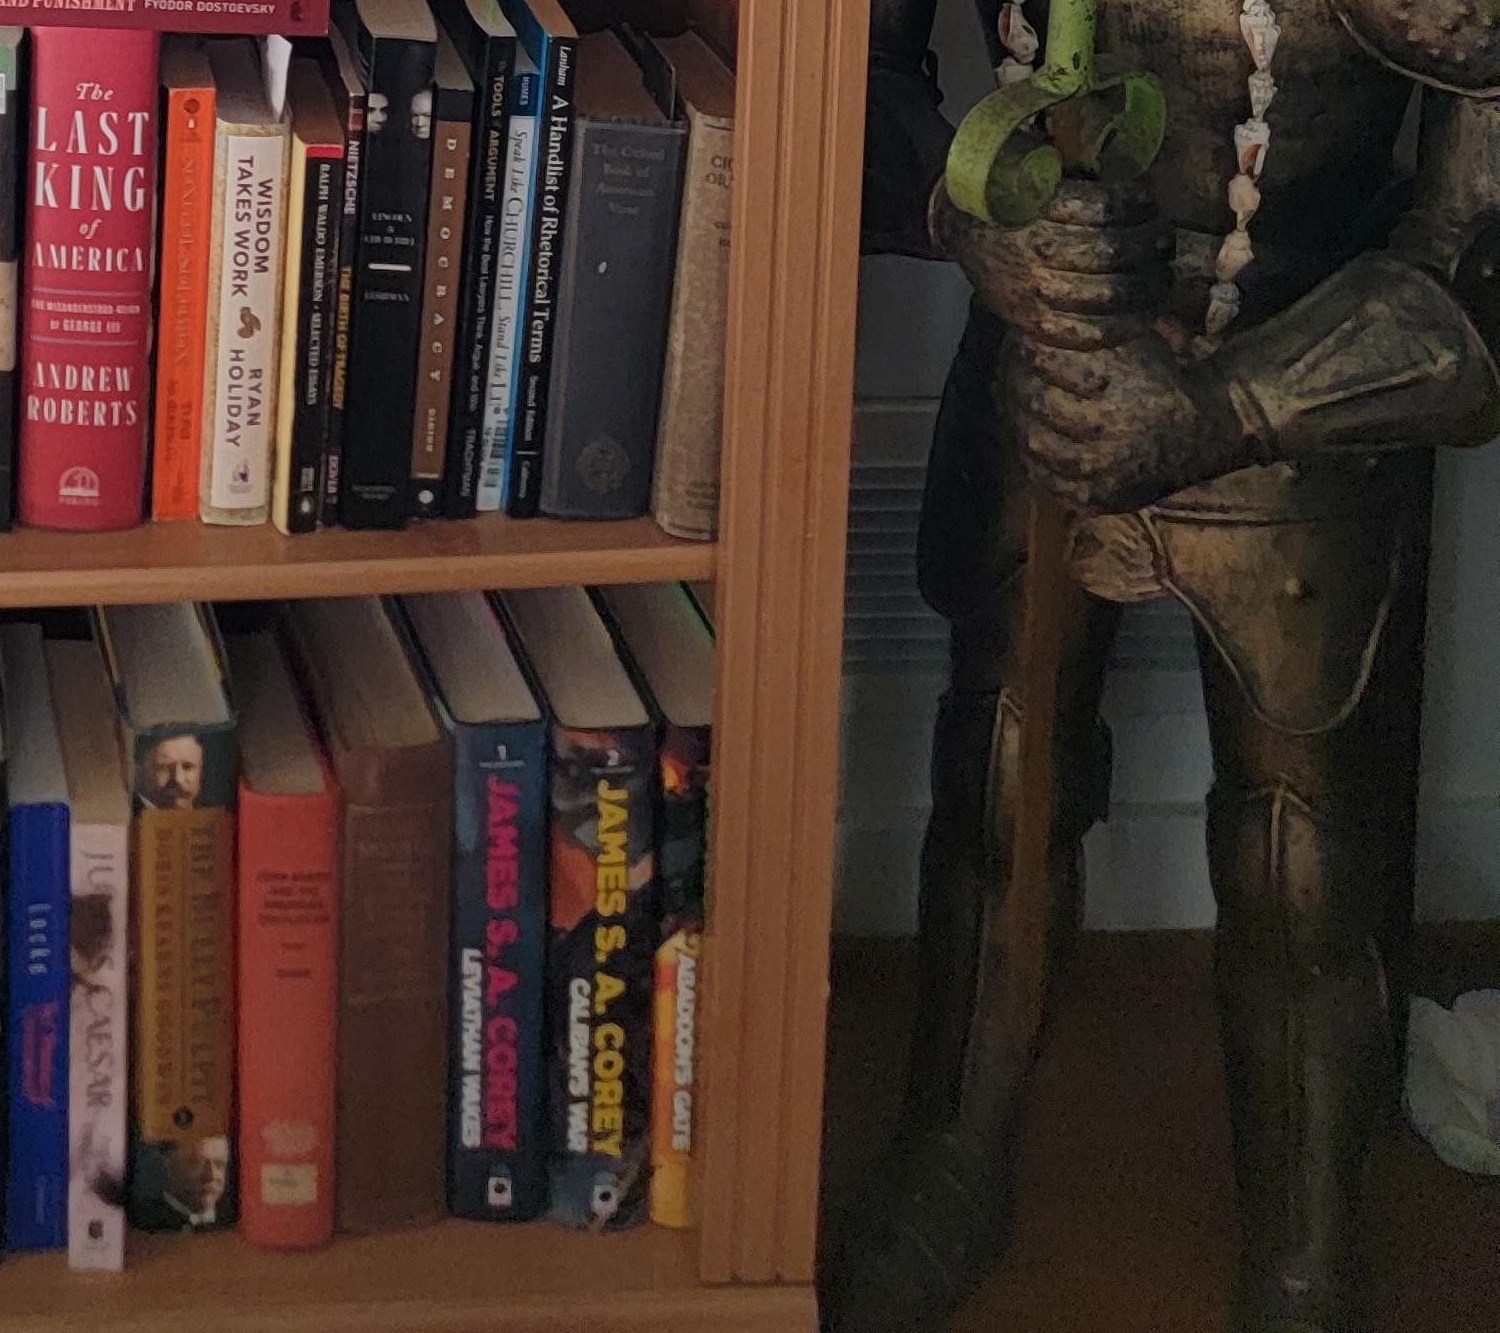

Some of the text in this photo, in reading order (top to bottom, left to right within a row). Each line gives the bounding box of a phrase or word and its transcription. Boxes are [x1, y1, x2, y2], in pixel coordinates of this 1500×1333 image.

[34, 109, 150, 158] LAST
[34, 165, 146, 212] KING
[345, 140, 360, 214] NIETZSCHE
[232, 155, 254, 298] TAKES WORK
[253, 178, 273, 274] WISDOM
[591, 779, 629, 1159] JAMES S. A. COREY
